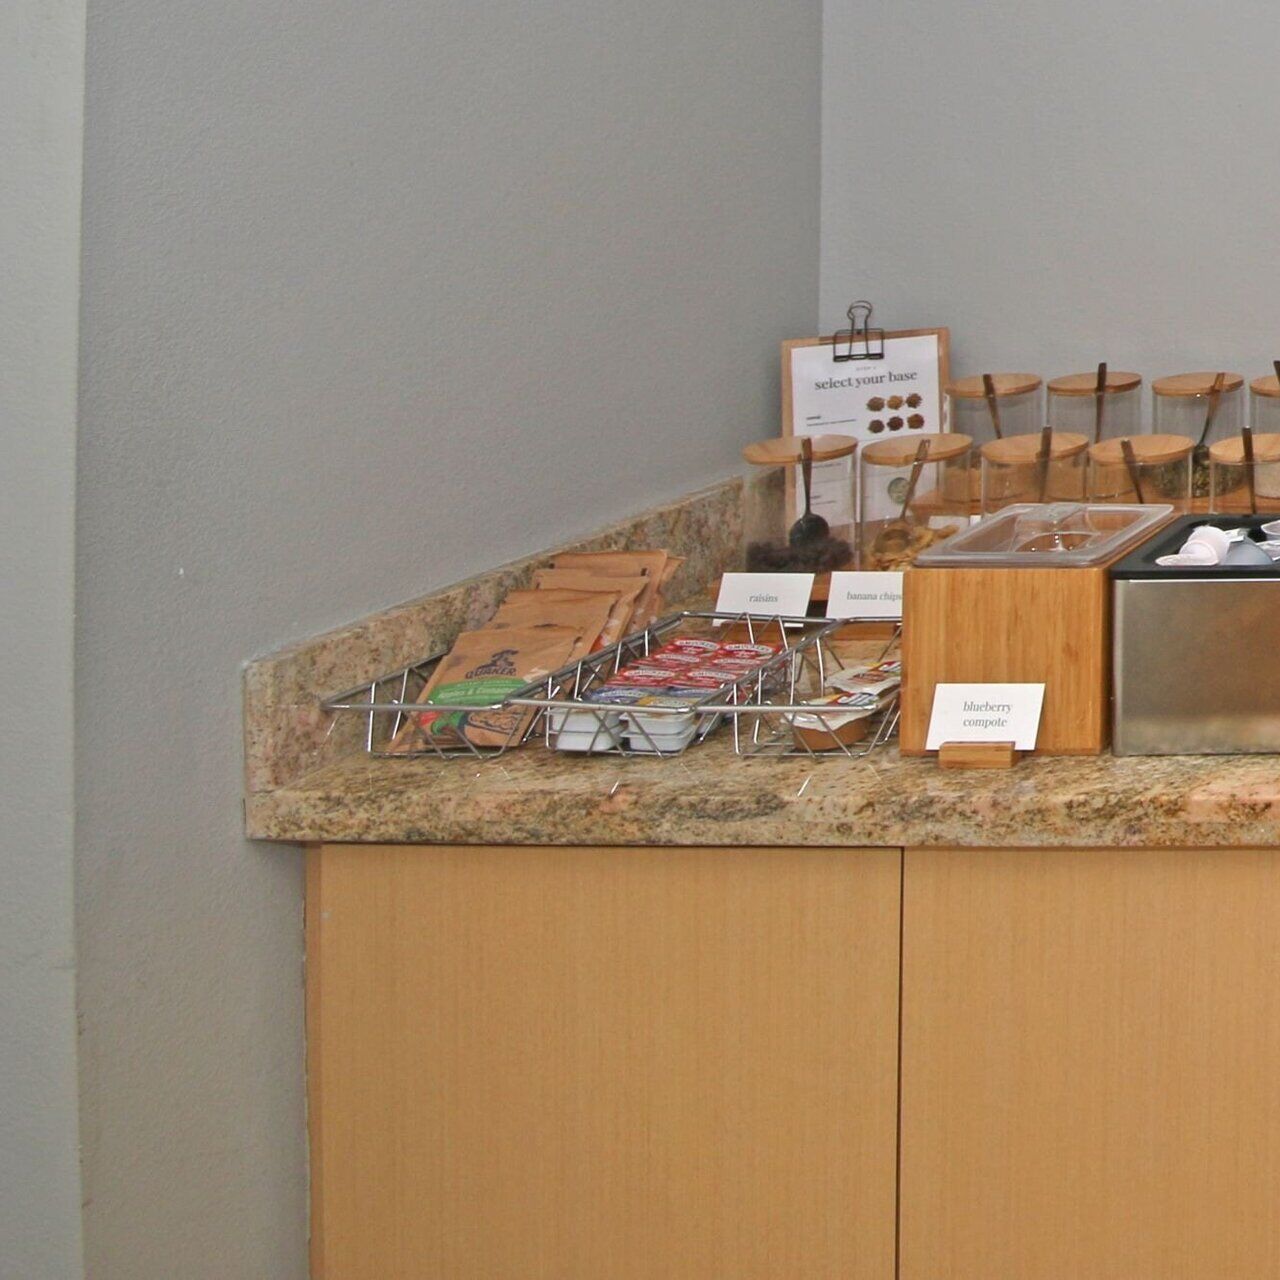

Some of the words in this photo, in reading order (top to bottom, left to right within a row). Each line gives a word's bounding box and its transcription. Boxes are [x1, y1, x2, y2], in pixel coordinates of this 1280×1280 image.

[814, 376, 853, 391] select
[855, 374, 886, 388] your
[889, 370, 918, 382] base
[749, 593, 779, 603] raisins
[846, 591, 878, 601] banana
[465, 667, 517, 679] QUAKER
[963, 701, 1012, 714] blueberry
[963, 718, 1008, 729] compote
